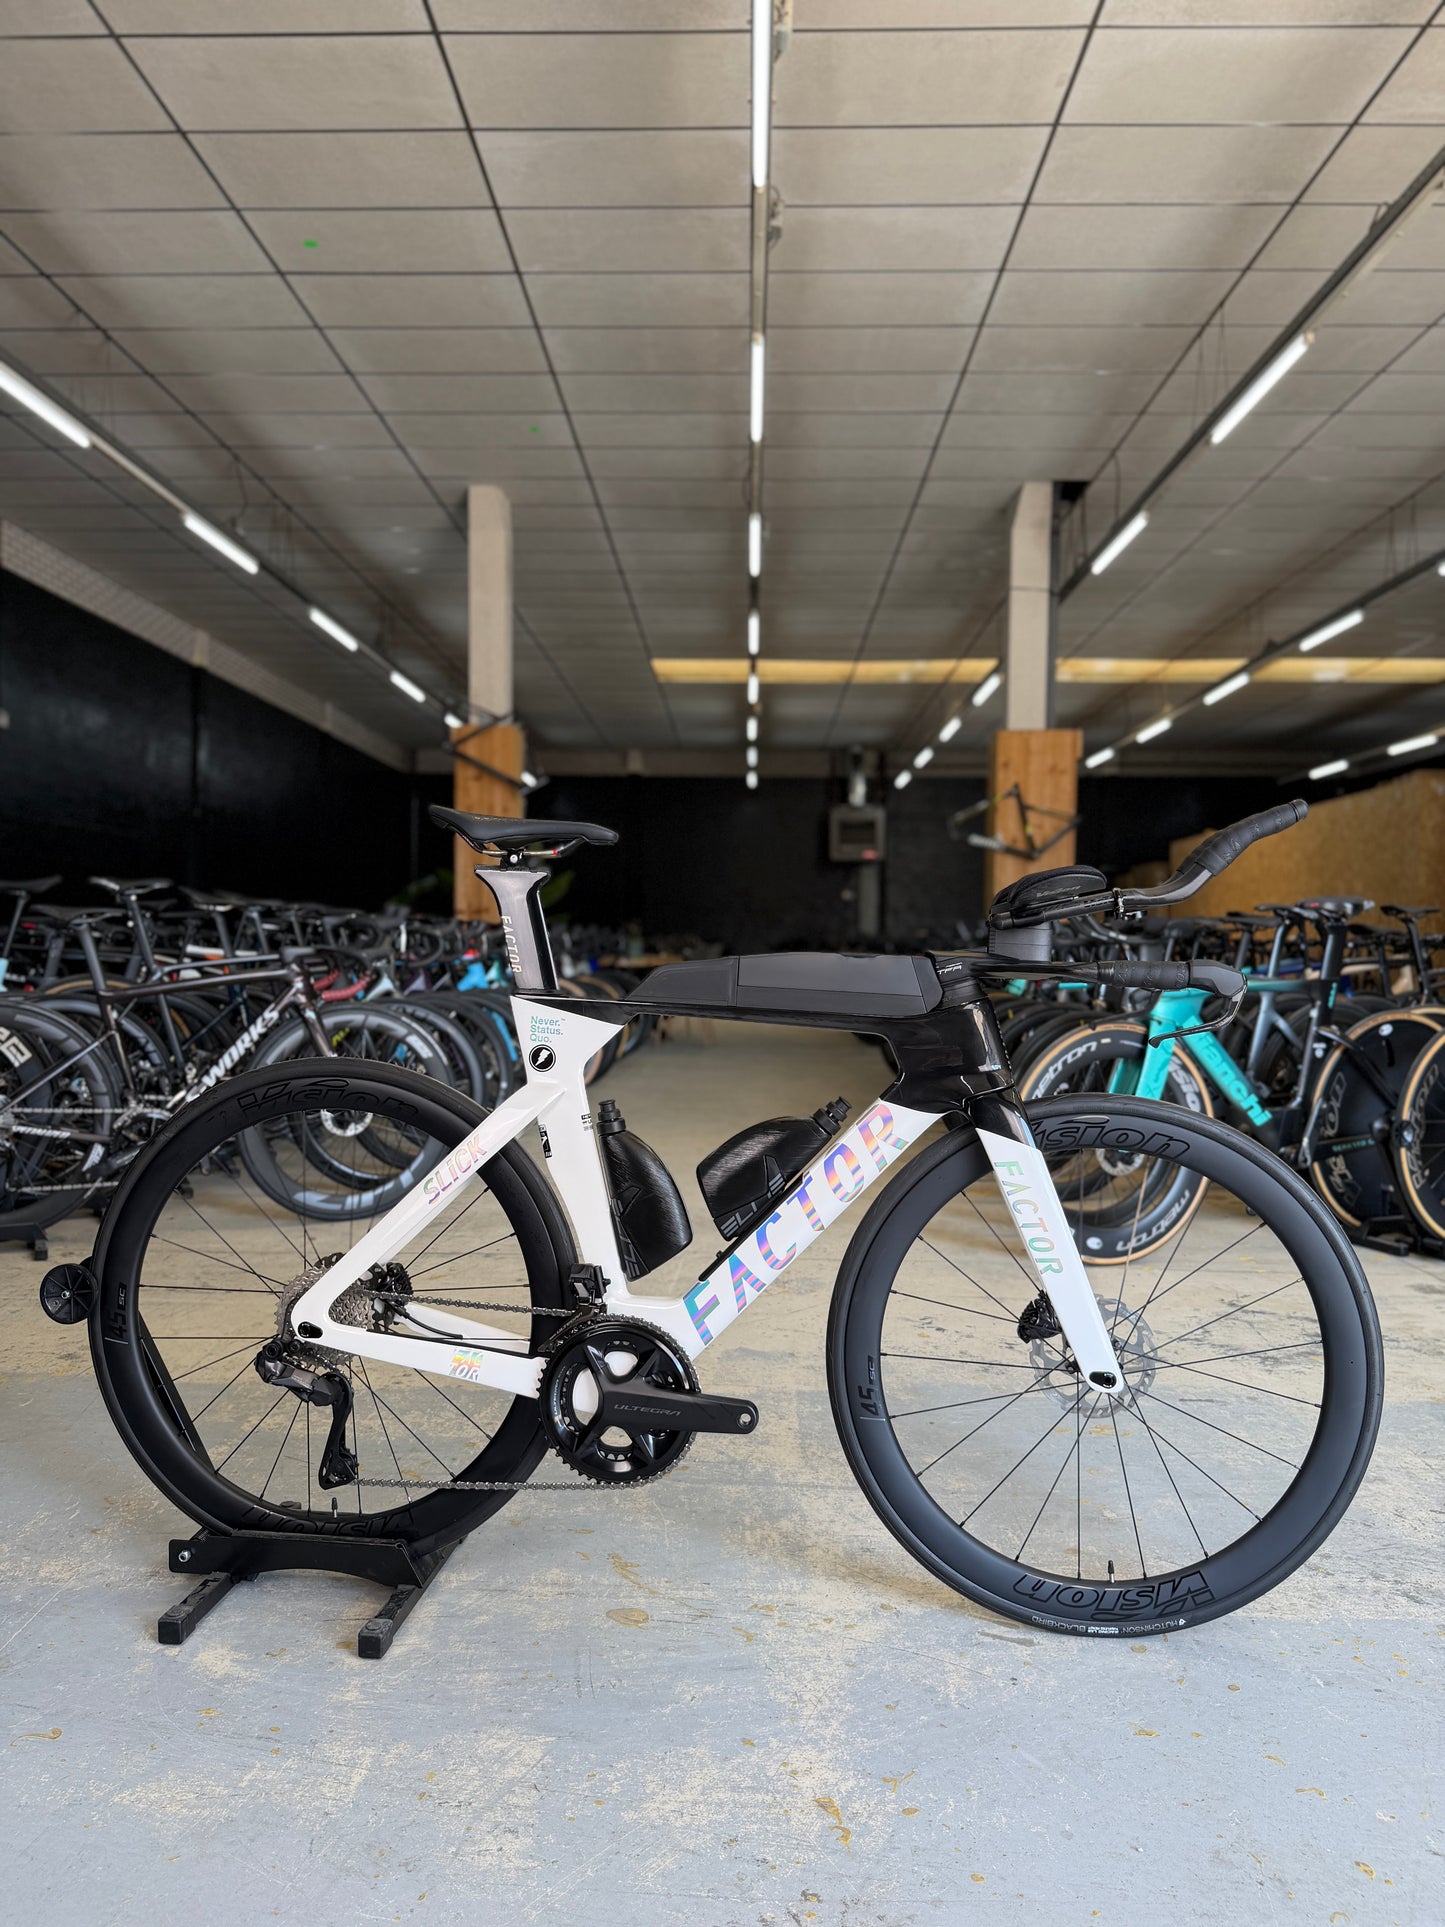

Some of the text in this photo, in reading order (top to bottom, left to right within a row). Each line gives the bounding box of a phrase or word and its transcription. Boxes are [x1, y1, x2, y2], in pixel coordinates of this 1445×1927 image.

[501, 915, 522, 973] FACTOR
[529, 1025, 564, 1036] Status.
[529, 1033, 552, 1043] Quo.
[683, 1103, 909, 1346] FACTOR
[994, 1161, 1064, 1275] FACTOR
[614, 1403, 682, 1418] ULTEGRA
[858, 1385, 880, 1417] 45
[1013, 1570, 1216, 1621] Vision
[1031, 1615, 1178, 1634] HUTCHINSON BLACKBIRD
